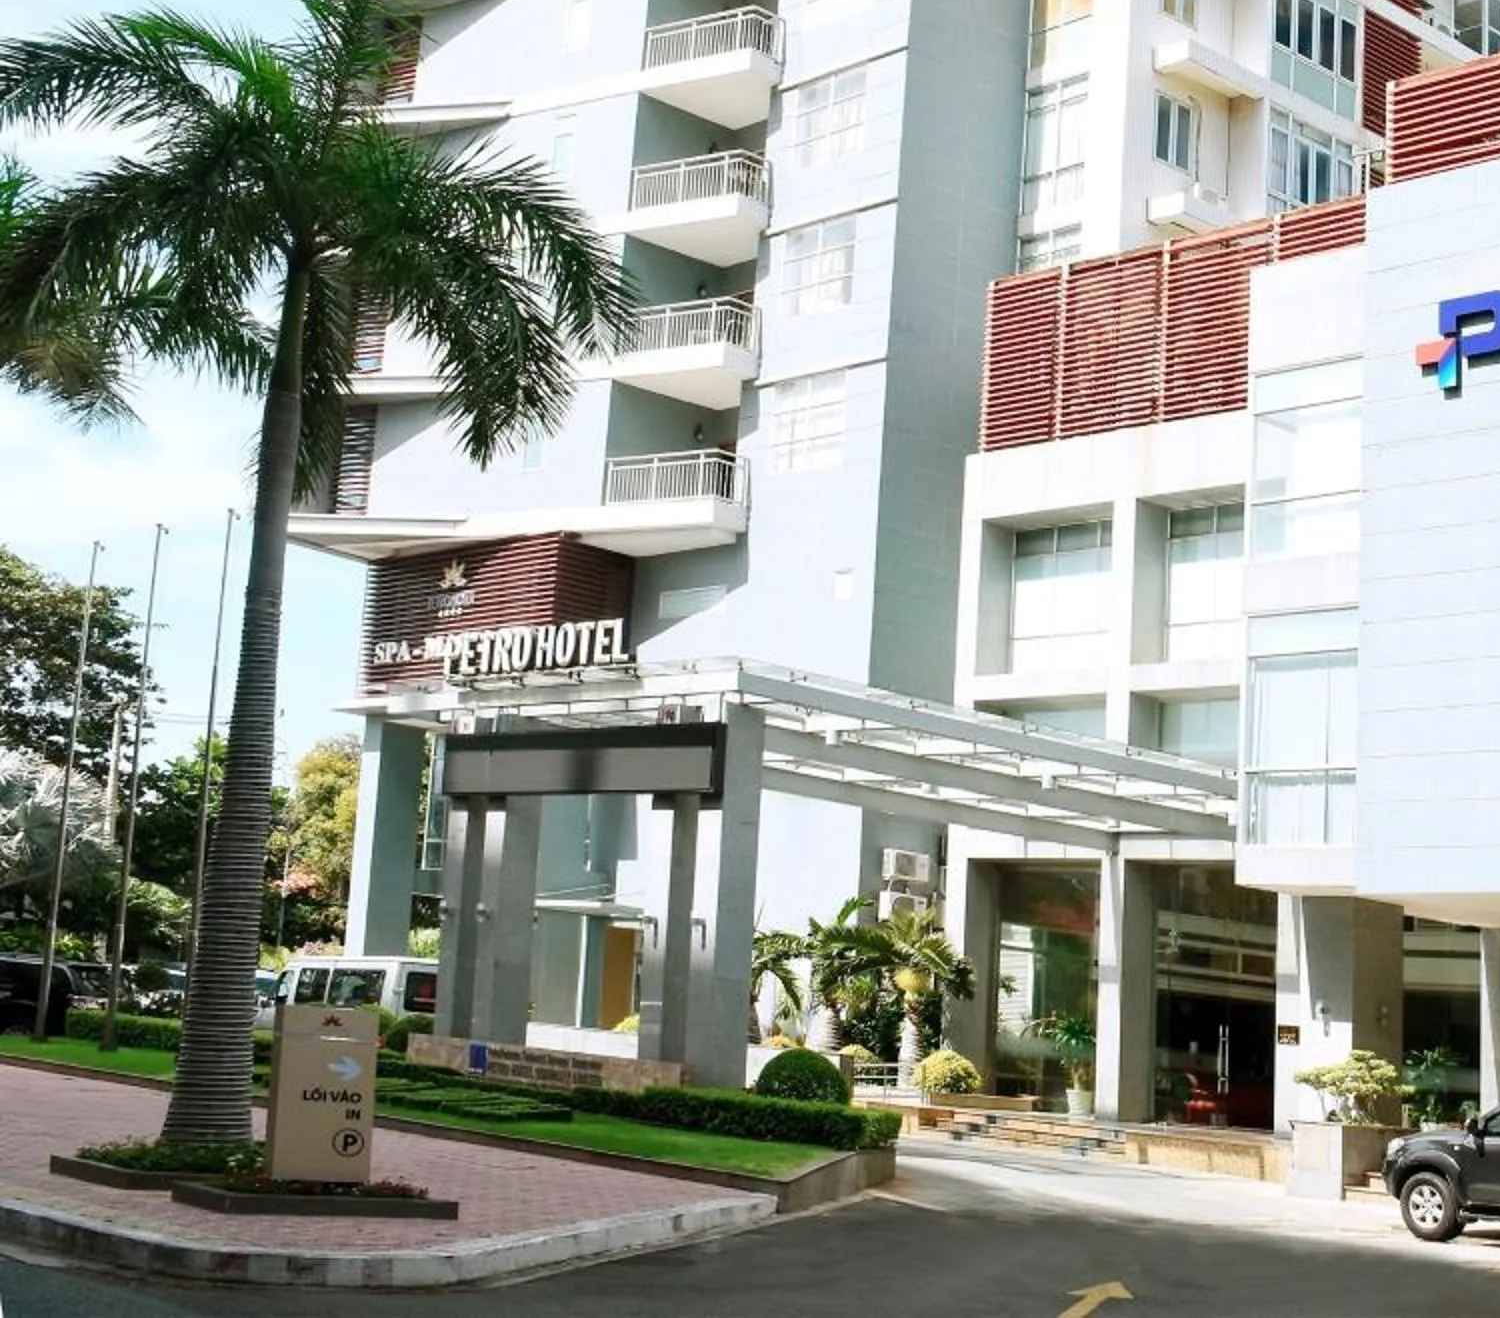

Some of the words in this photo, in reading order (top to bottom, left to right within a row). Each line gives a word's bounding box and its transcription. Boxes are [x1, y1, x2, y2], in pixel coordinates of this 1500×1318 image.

[374, 640, 413, 664] SPA
[444, 625, 533, 676] PETRO
[535, 618, 630, 669] HOTEL
[345, 1109, 361, 1121] IN
[342, 1133, 358, 1152] P
